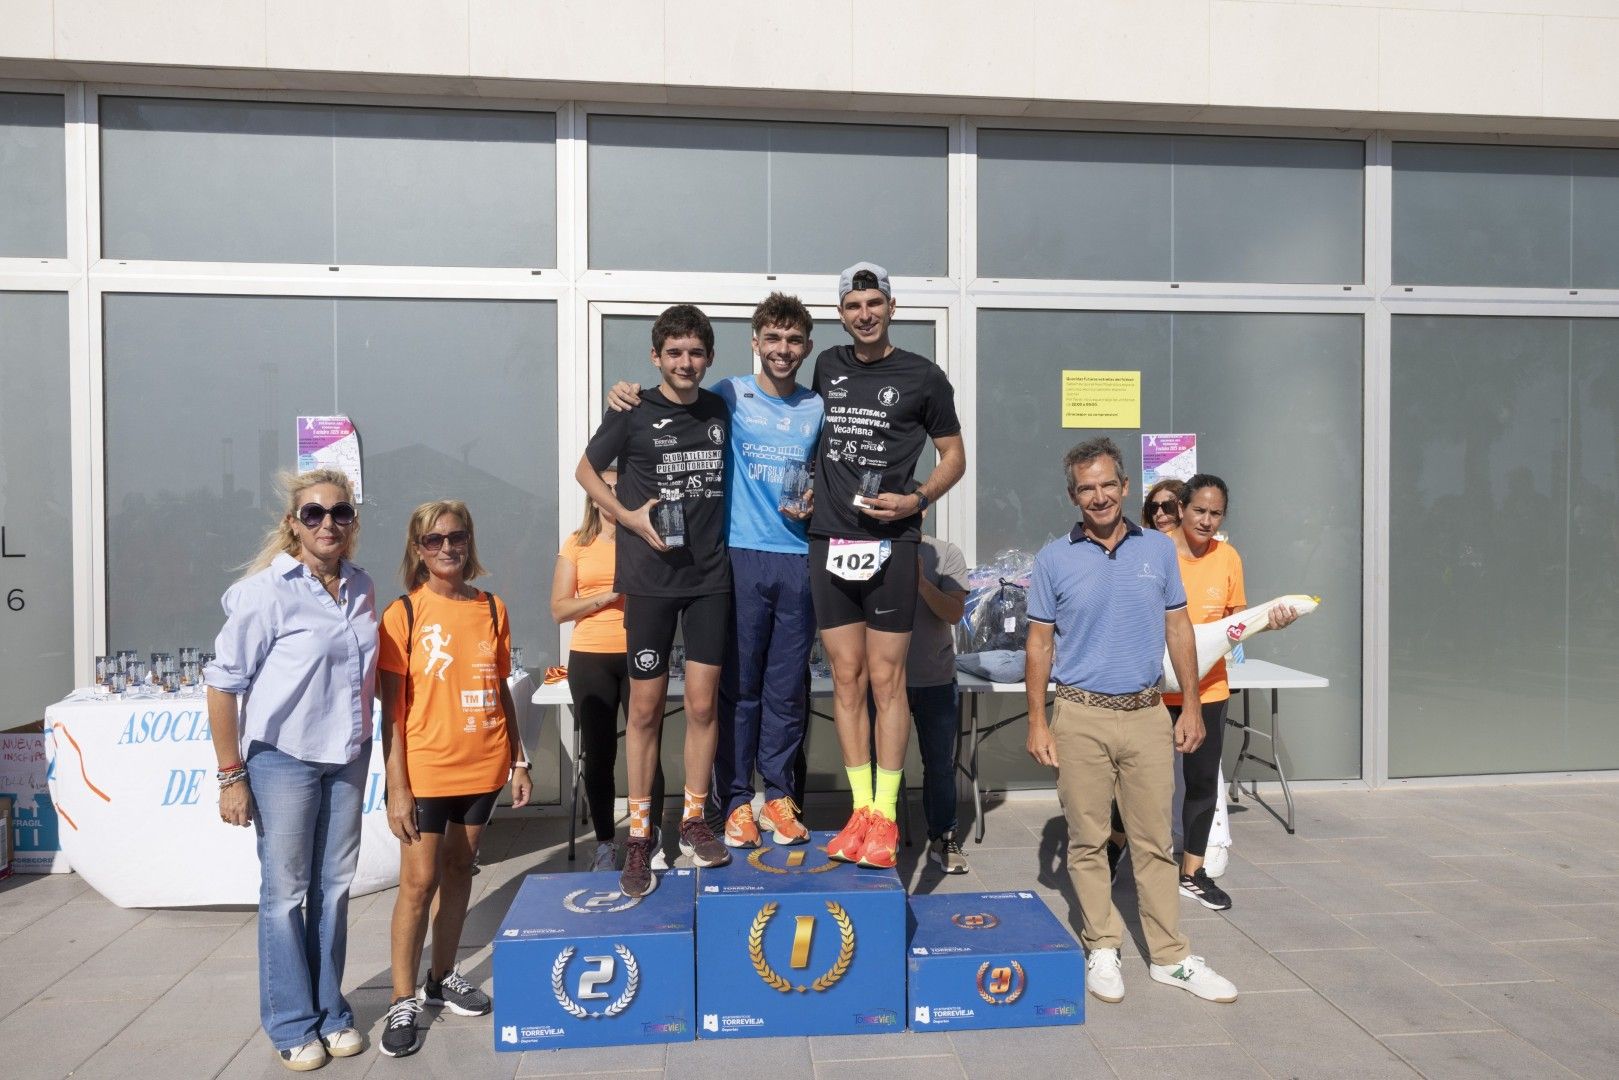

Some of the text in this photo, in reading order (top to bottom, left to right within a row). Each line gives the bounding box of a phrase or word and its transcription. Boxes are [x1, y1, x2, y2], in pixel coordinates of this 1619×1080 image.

[830, 406, 887, 418] CLUB ATLETISMO
[848, 416, 891, 429] TORREVIEJA
[742, 442, 777, 453] grupo
[843, 440, 858, 454] AS
[663, 452, 682, 463] CLUB
[657, 462, 686, 473] PUERTO
[686, 475, 702, 489] AS
[833, 553, 875, 571] 102
[7, 588, 26, 612] 6
[464, 695, 479, 703] TM
[118, 710, 212, 745] ASOCIA
[161, 769, 207, 806] DE
[585, 891, 623, 907] 2
[578, 955, 615, 999] 2
[989, 967, 1013, 994] 3
[521, 1028, 565, 1036] TORREVIEJA
